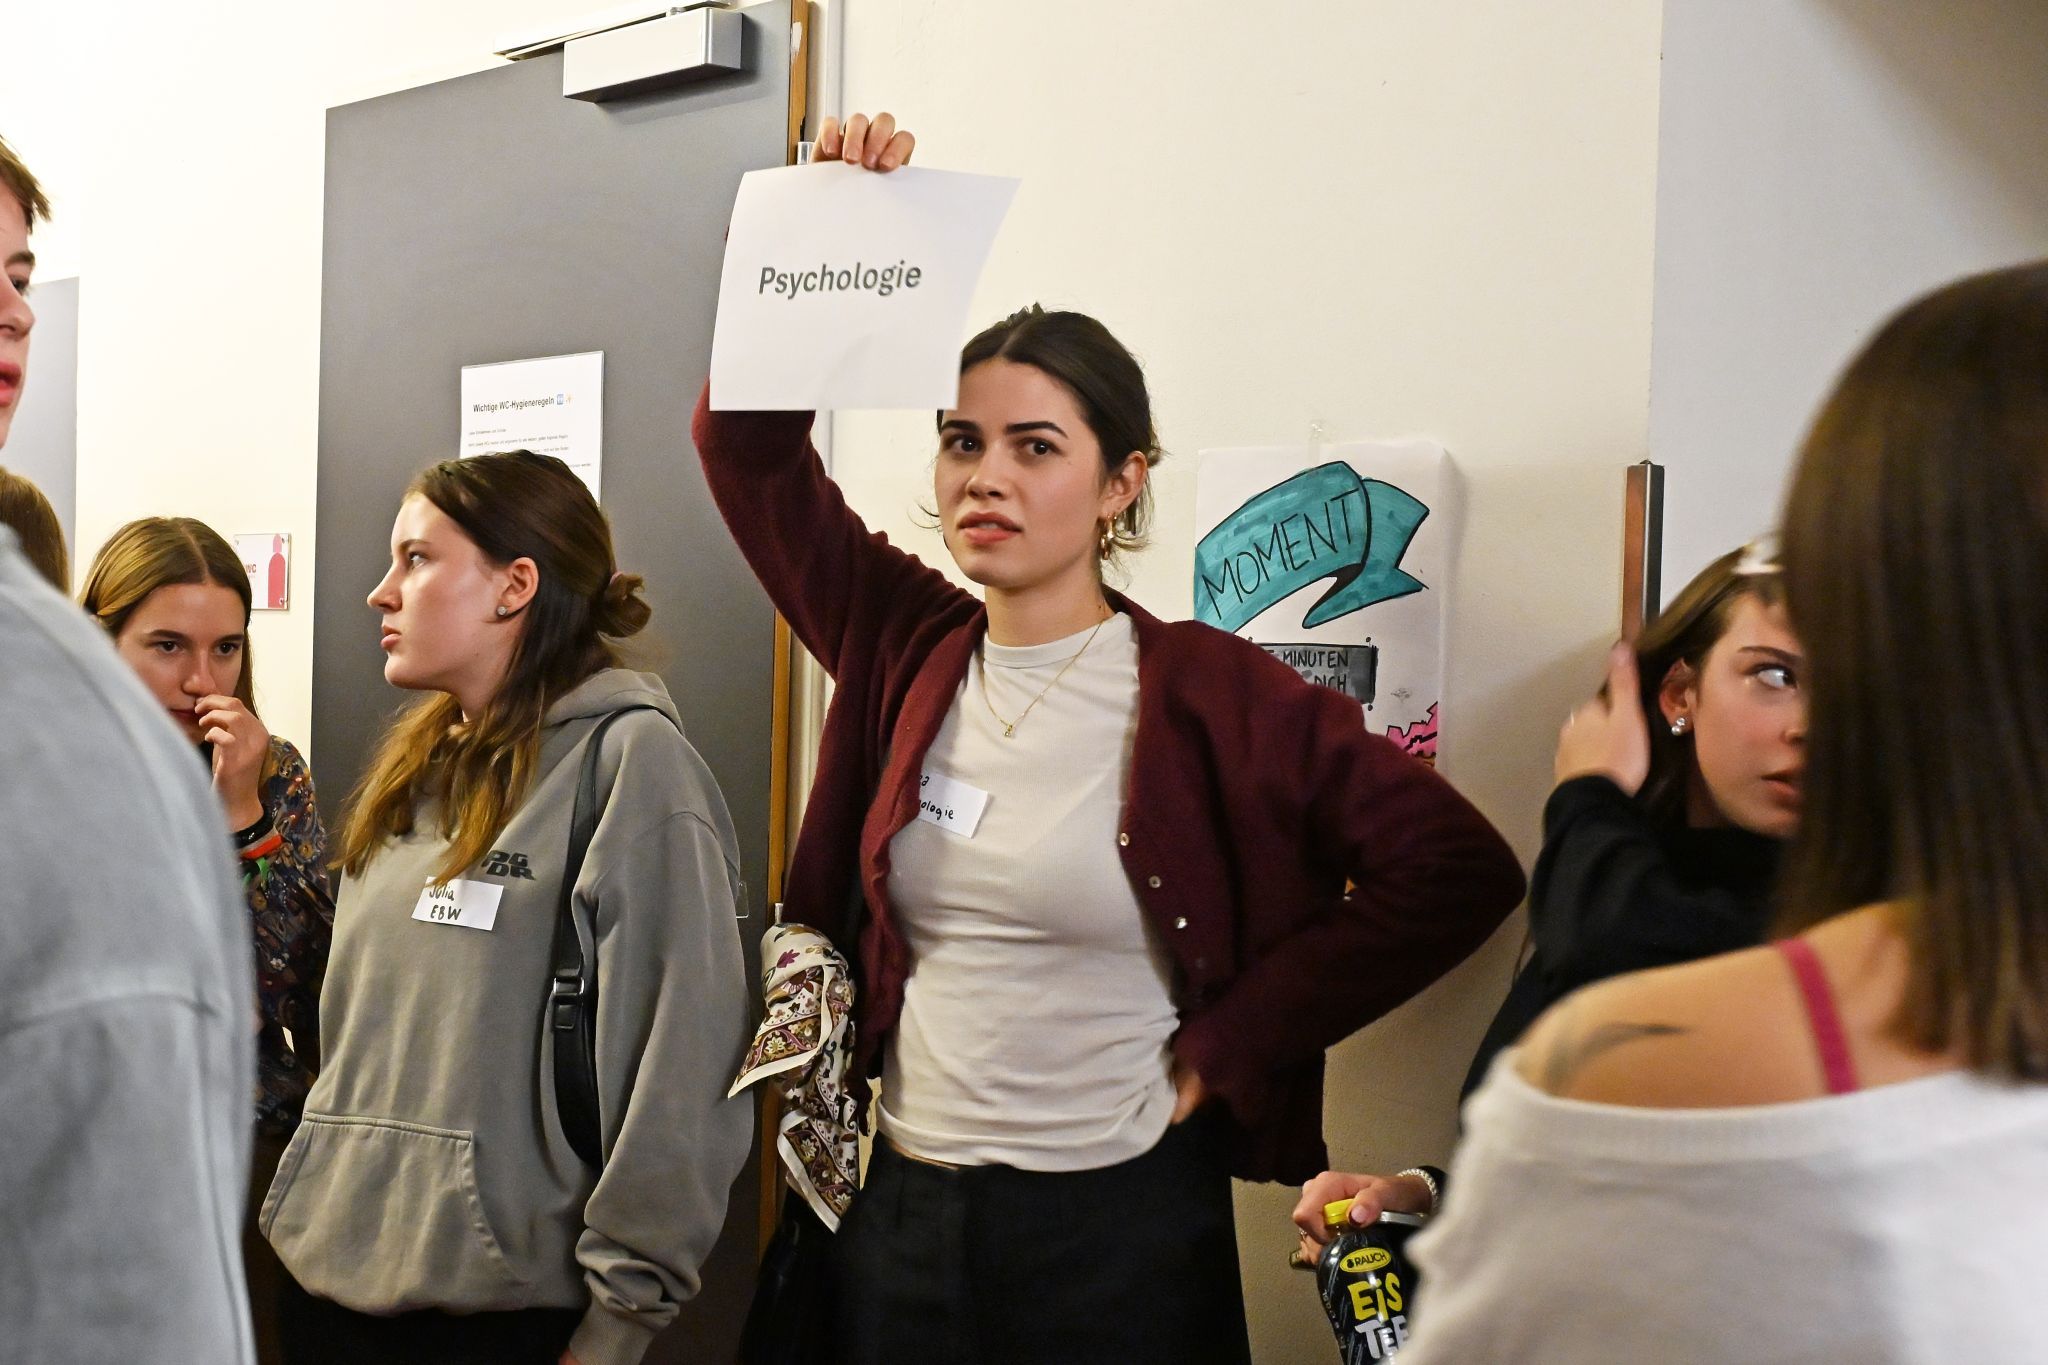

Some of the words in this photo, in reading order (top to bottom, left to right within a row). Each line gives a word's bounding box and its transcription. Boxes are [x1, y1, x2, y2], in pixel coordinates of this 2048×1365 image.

[758, 259, 922, 300] Psychologie
[473, 403, 498, 414] Wichtige
[499, 396, 555, 411] WC-Hygieneregeln
[1201, 488, 1360, 620] MOMENT
[1282, 650, 1349, 668] MINUTEN
[1353, 1251, 1387, 1268] RAUCH
